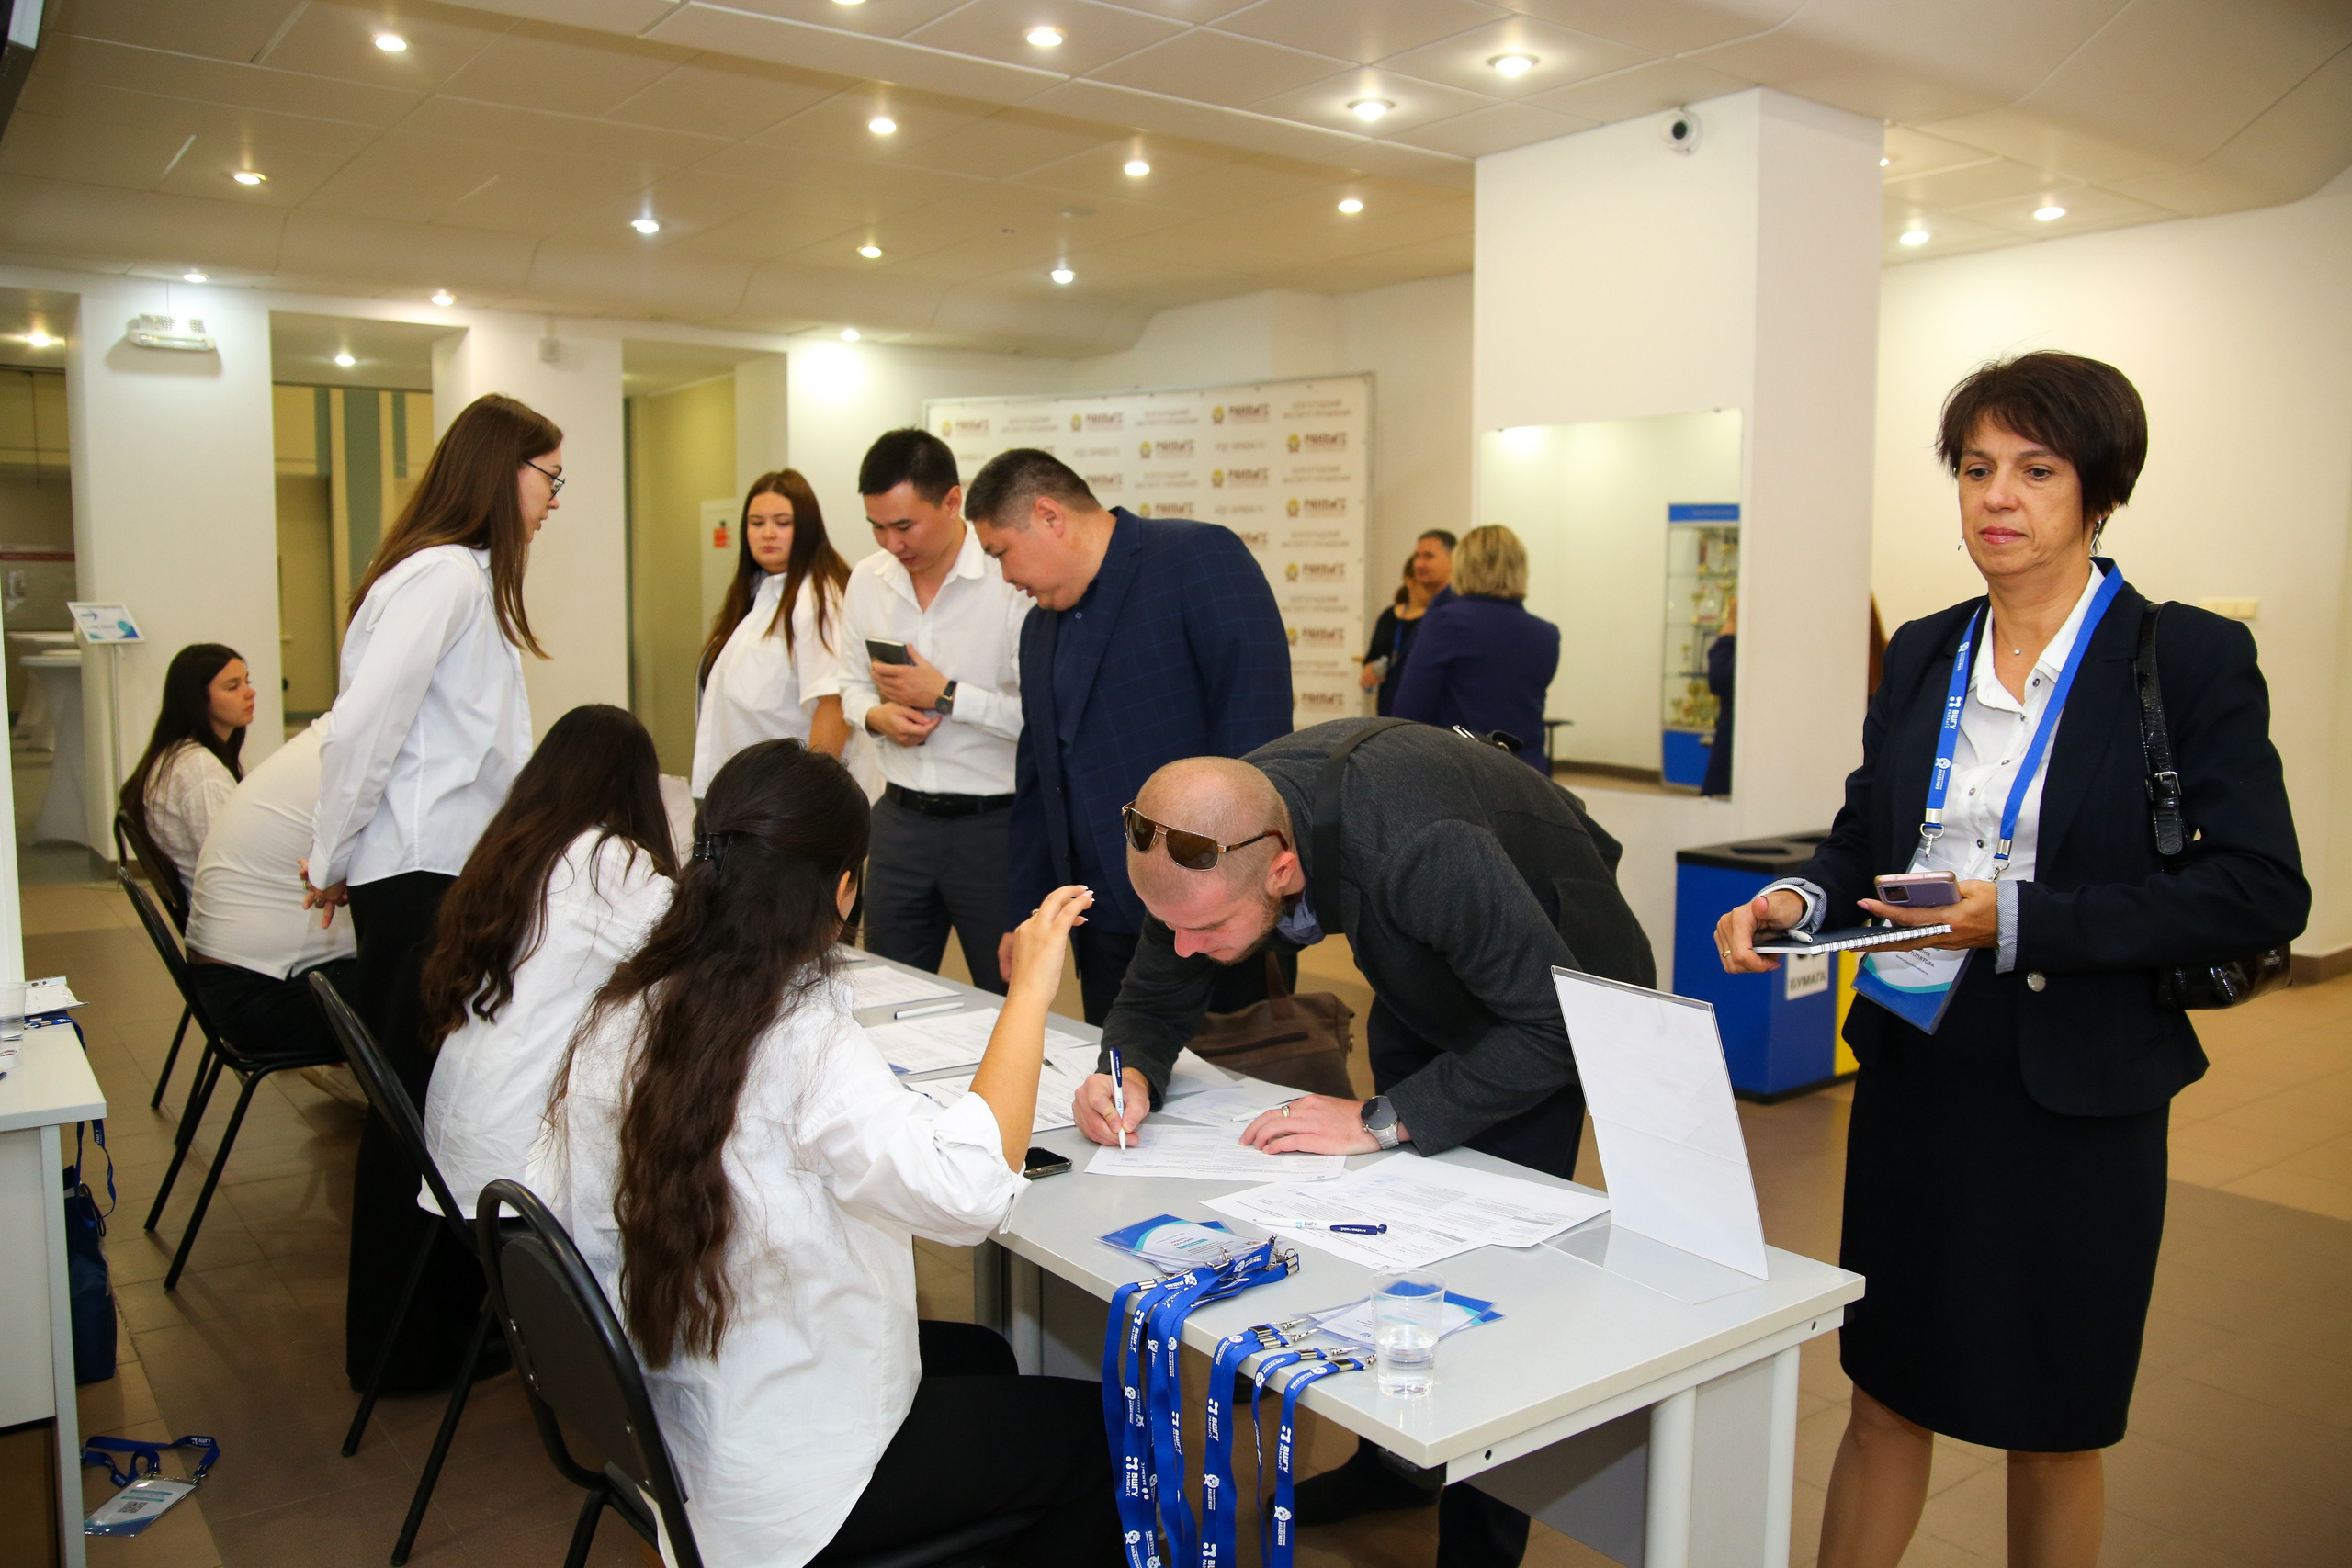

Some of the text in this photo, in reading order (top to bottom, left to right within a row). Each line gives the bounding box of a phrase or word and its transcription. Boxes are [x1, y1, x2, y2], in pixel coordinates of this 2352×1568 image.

[1950, 709, 1959, 729] ВШГУ
[1791, 970, 1826, 990] БУМАГА
[1132, 1327, 1140, 1353] ВШГУ
